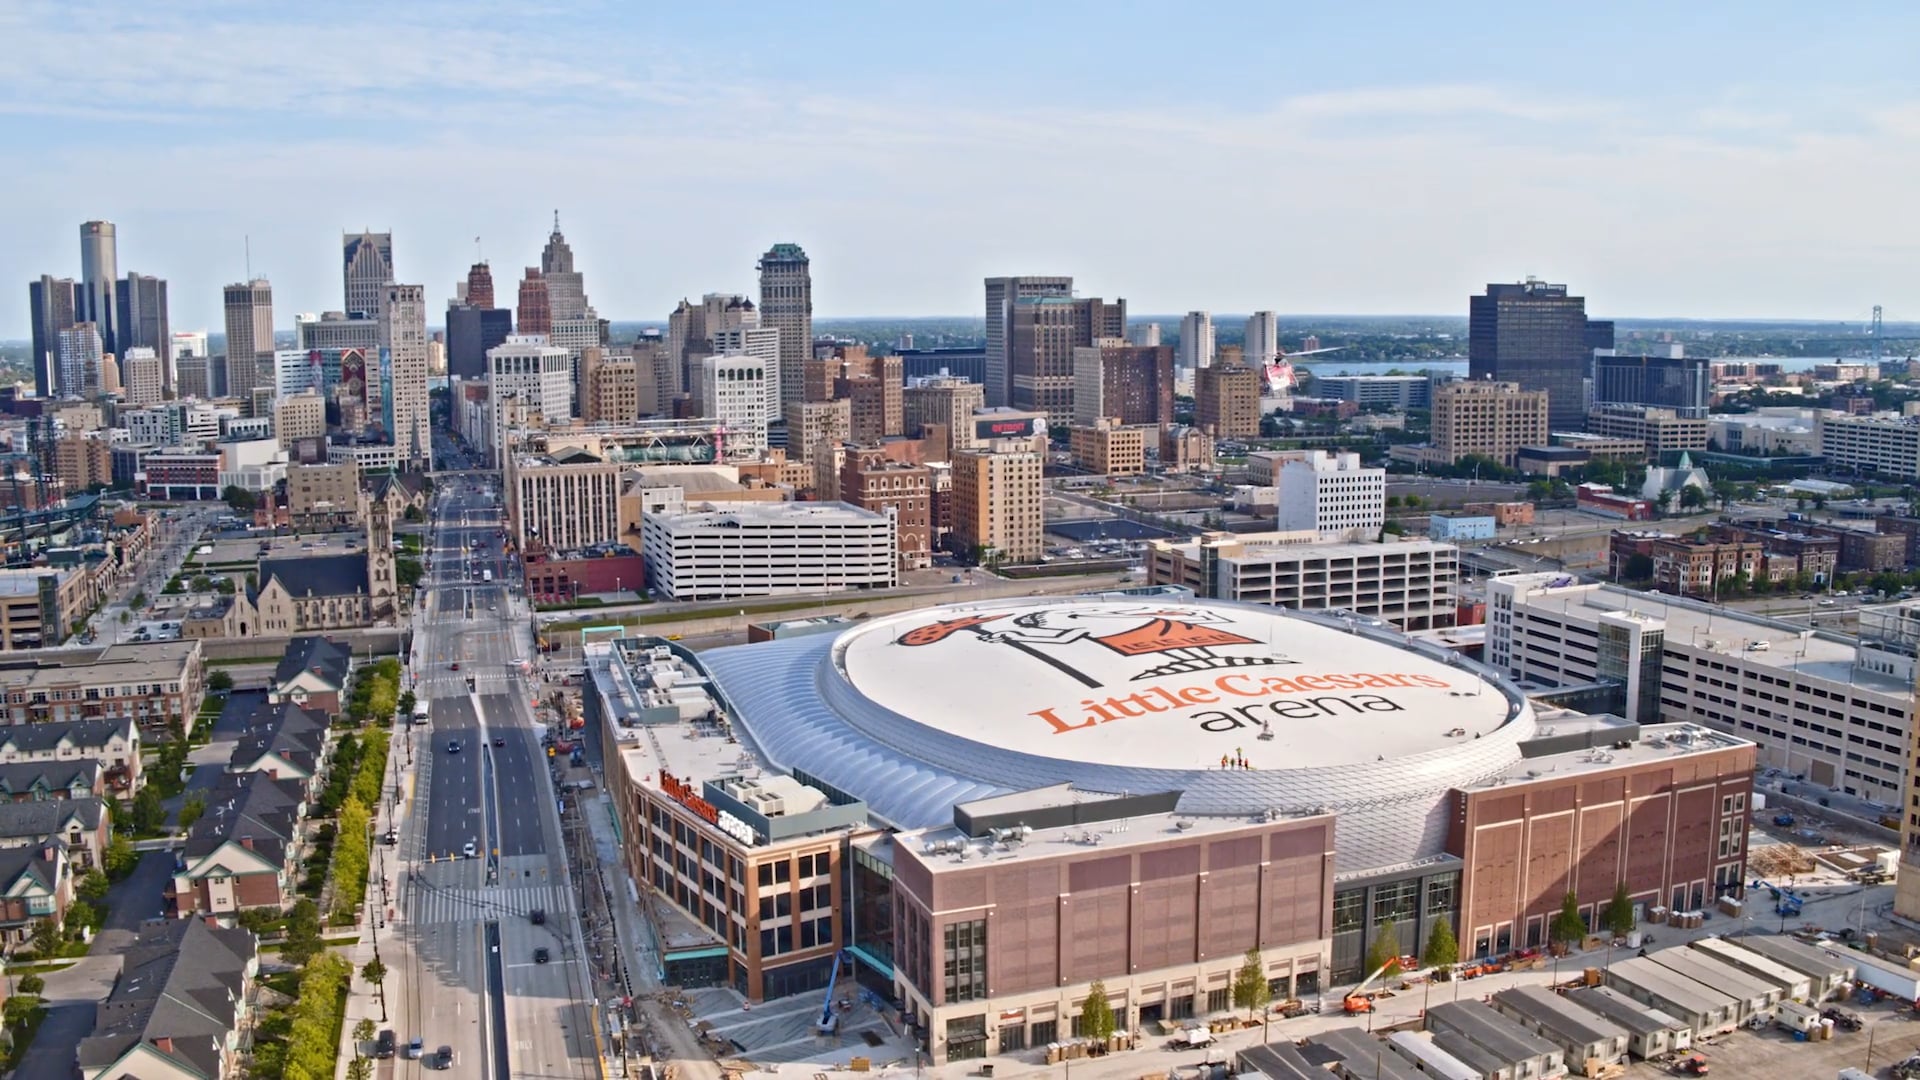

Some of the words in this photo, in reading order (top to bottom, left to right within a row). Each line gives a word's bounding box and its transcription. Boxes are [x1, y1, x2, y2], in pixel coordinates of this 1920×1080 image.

[991, 423, 1025, 432] DETROIT
[1028, 686, 1221, 735] Little
[1215, 672, 1450, 698] Caesars
[1190, 694, 1406, 732] arena
[718, 810, 753, 845] arena
